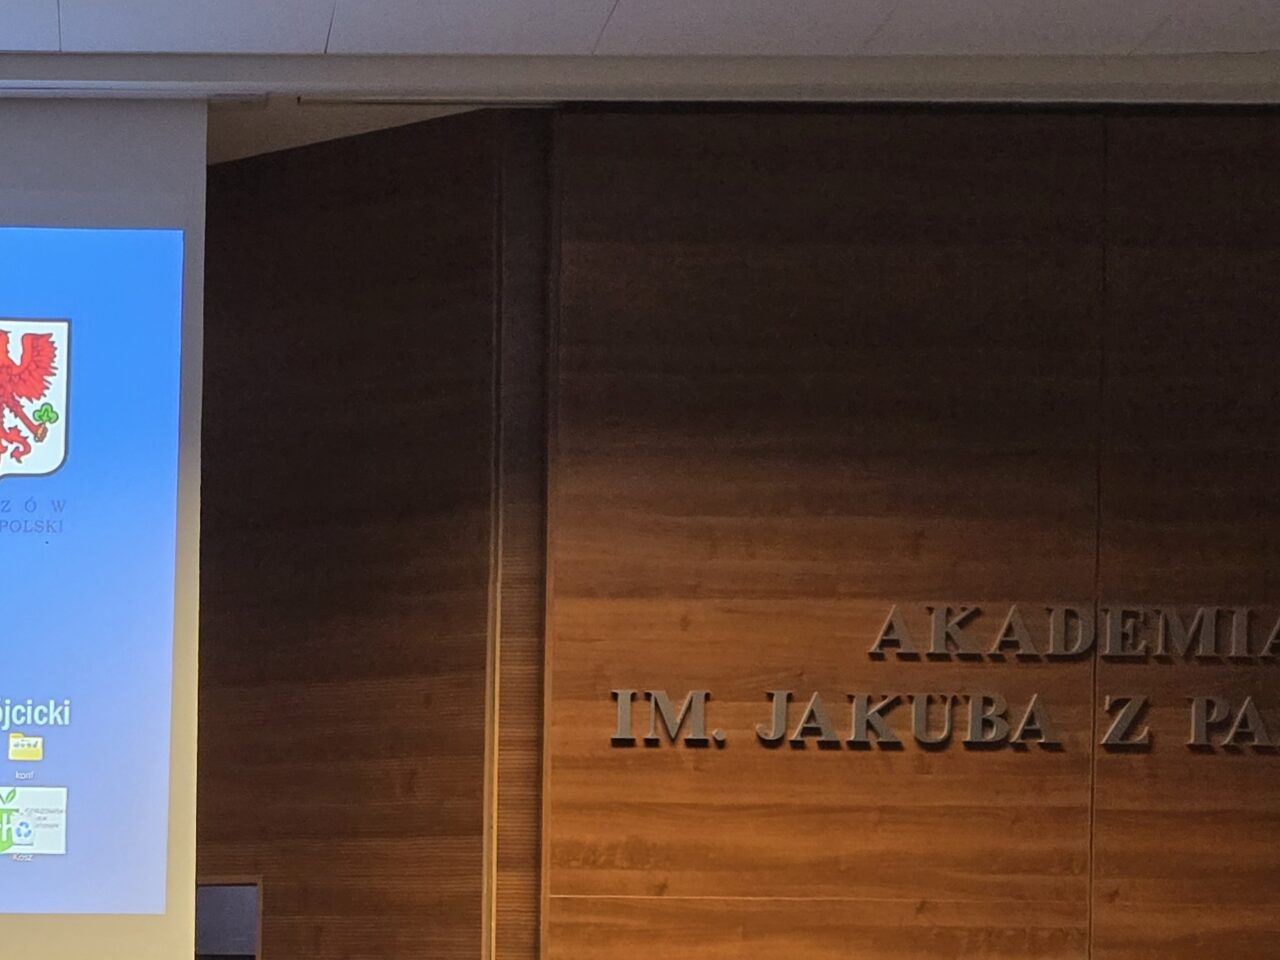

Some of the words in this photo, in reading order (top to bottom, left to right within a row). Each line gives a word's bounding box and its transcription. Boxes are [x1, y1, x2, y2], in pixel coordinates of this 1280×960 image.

[610, 689, 726, 746] IM.
[756, 691, 1064, 750] JAKUBA
[1099, 696, 1151, 752] Z
